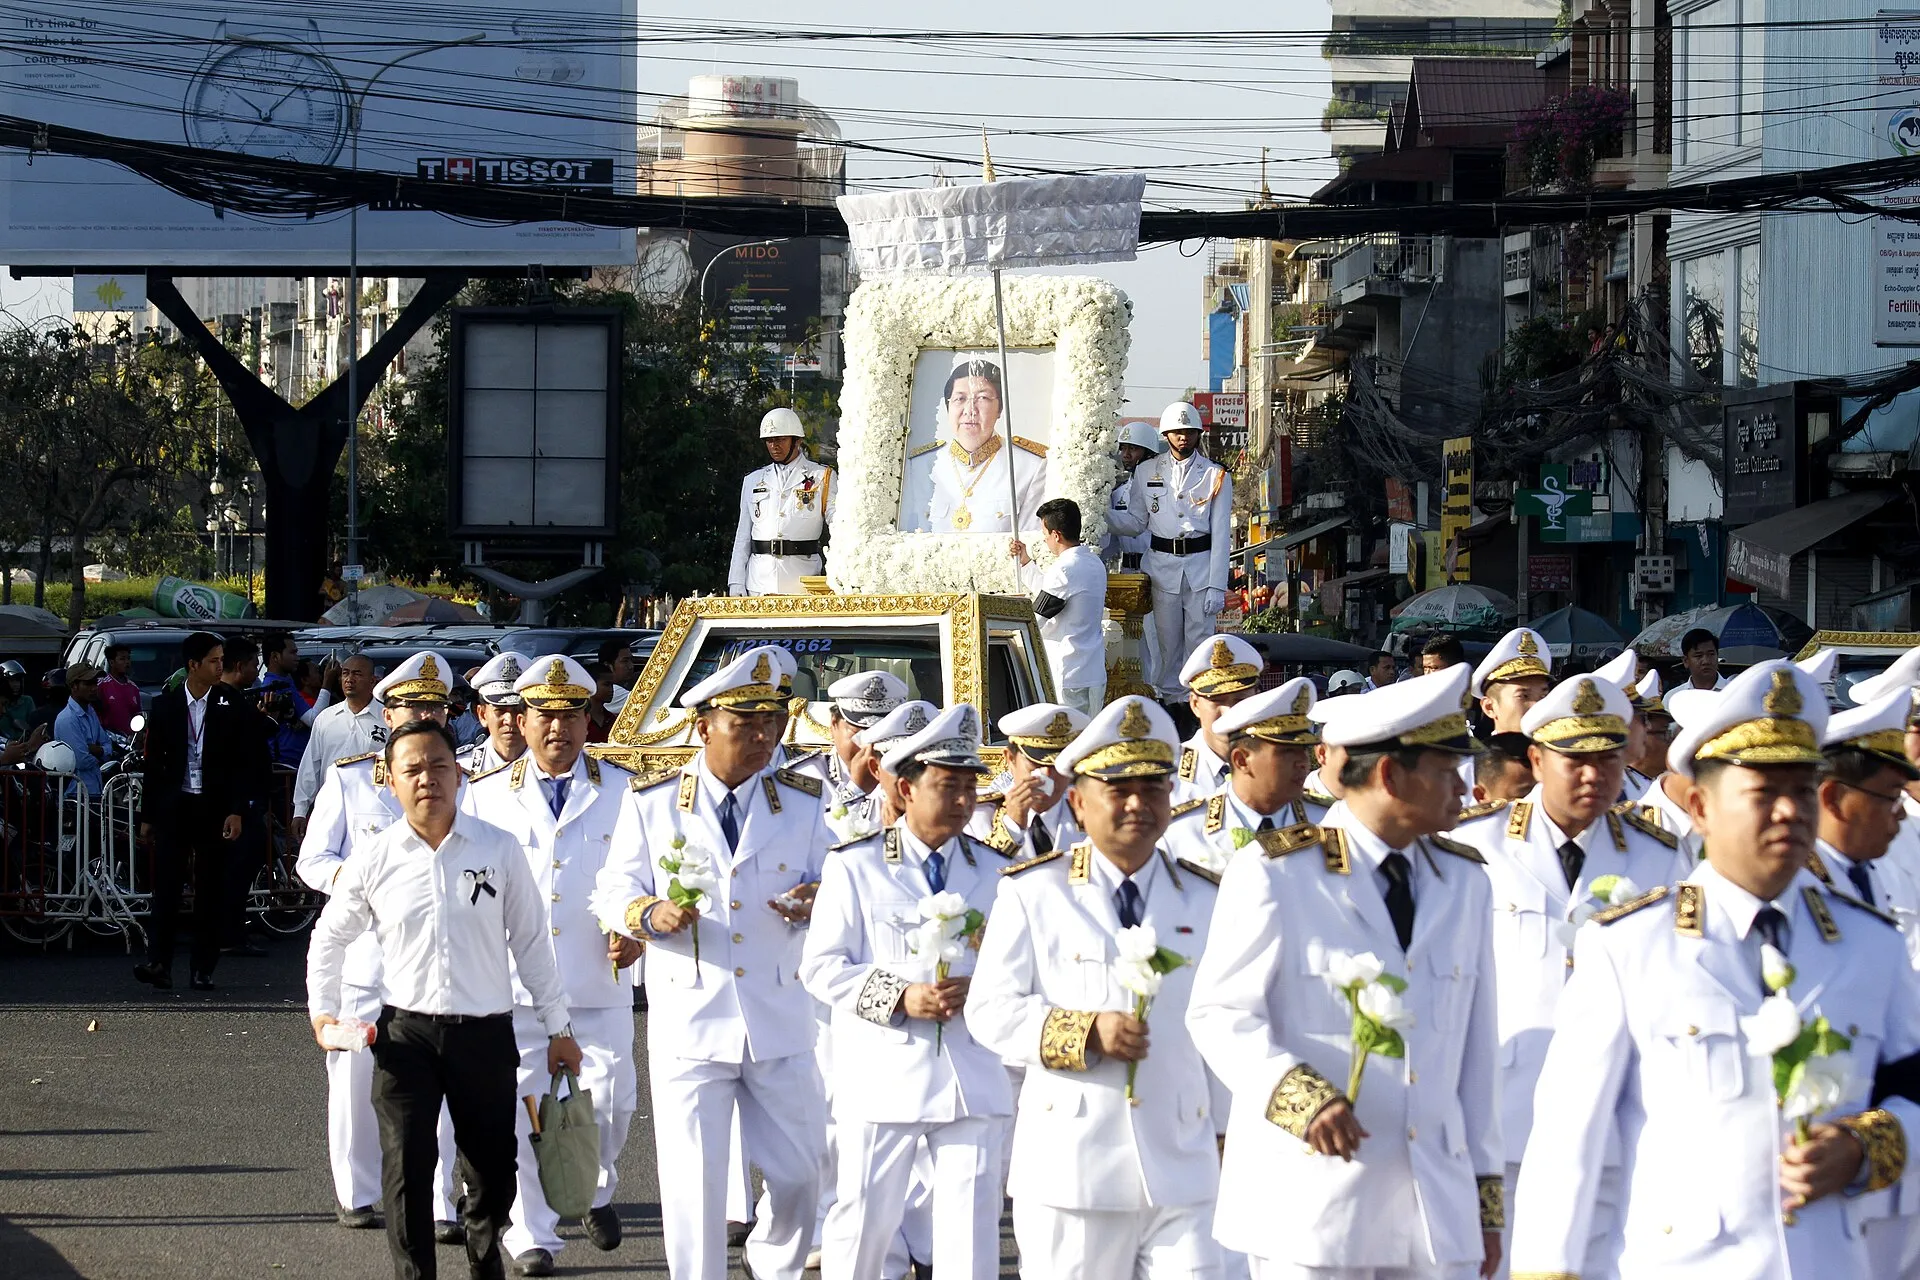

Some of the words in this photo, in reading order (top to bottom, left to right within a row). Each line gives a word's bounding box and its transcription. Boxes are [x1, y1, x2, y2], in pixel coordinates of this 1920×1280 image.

[48, 18, 76, 28] time
[80, 17, 97, 28] for
[24, 56, 58, 64] come
[478, 160, 593, 181] TISSOT
[735, 246, 780, 259] MIDO
[1220, 416, 1239, 424] VIP
